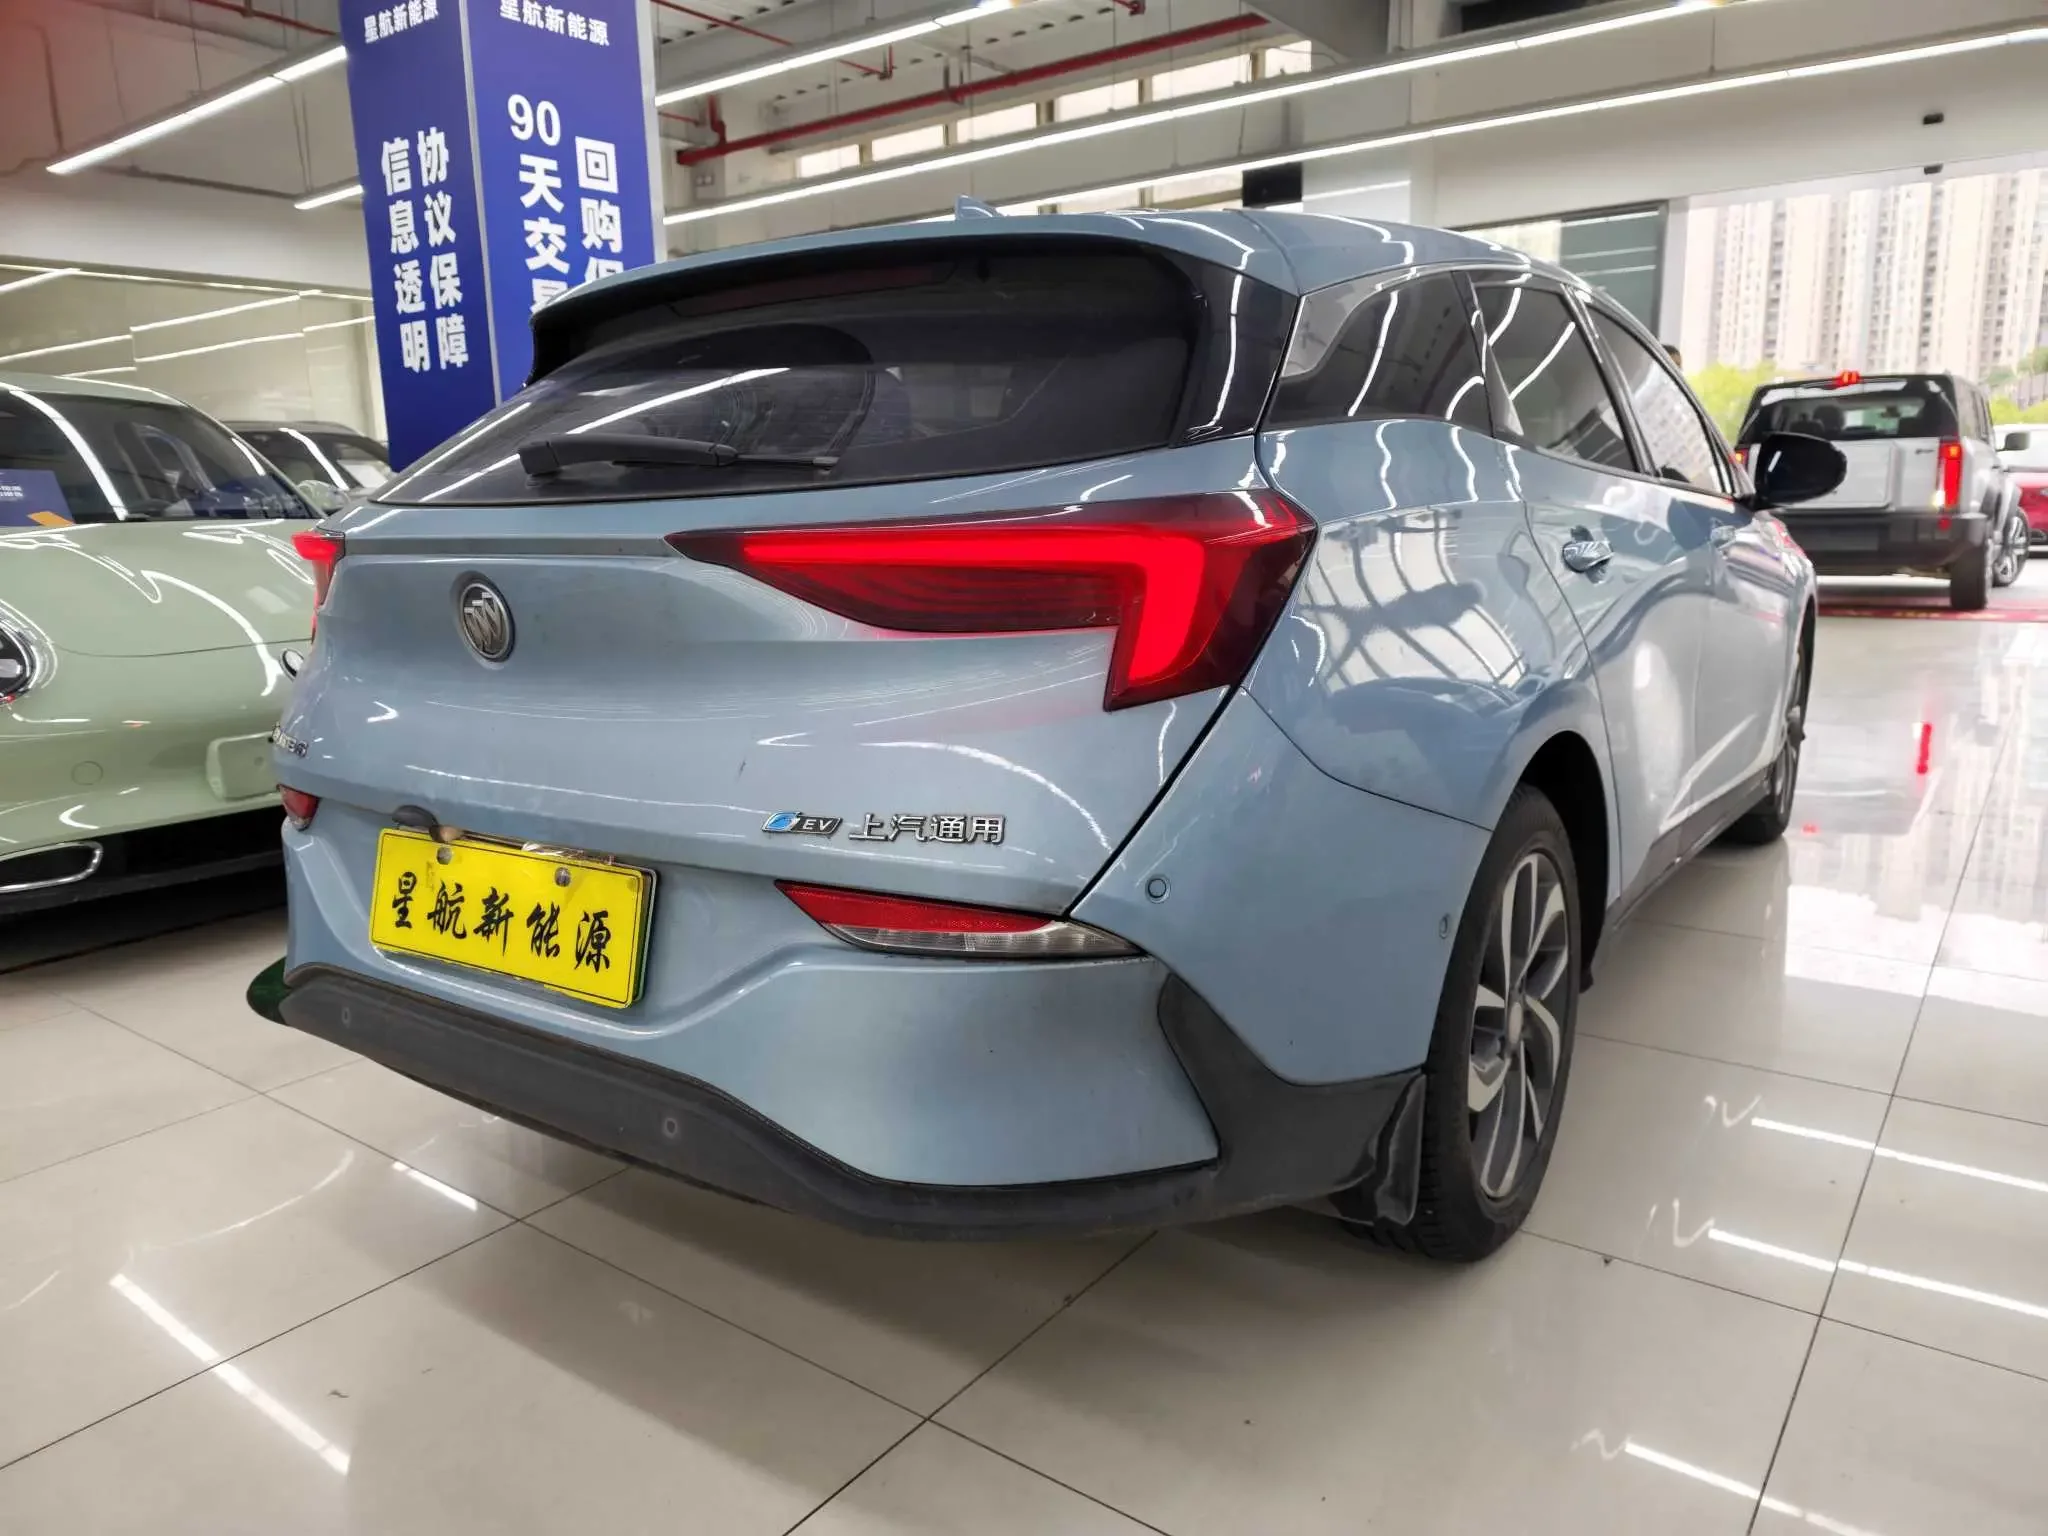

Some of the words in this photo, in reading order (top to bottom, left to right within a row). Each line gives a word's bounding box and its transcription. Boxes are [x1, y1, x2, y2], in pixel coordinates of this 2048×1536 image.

[363, 0, 439, 44] 星航新能源
[500, 0, 610, 46] 星航新能源
[381, 137, 431, 374] 信息透明
[417, 127, 469, 370] 协议保障
[803, 819, 833, 831] EV
[849, 813, 1006, 844] 上汽通用
[392, 871, 611, 973] 星航新能源
